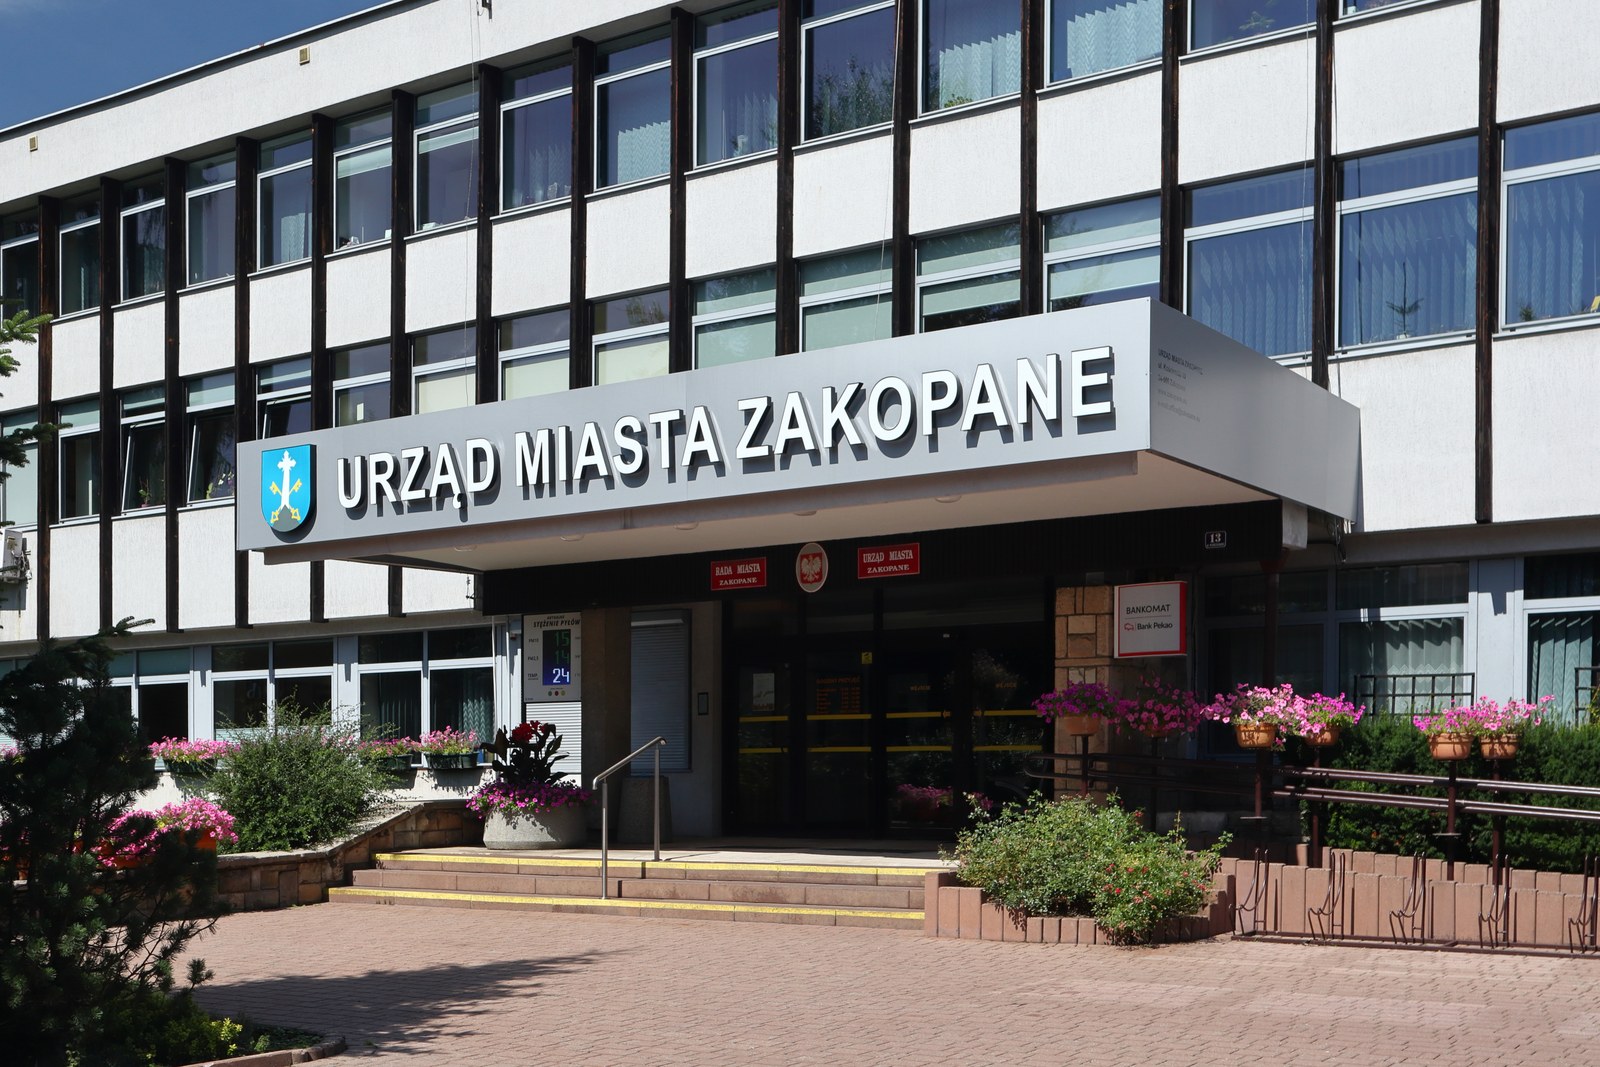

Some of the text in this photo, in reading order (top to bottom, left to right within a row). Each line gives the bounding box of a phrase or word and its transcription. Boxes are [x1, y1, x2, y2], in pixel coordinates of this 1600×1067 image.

[337, 345, 1114, 510] URZĄD MIASTA ZAKOPANE
[1210, 533, 1221, 543] 13
[863, 549, 914, 564] URZĄD MIASTA
[715, 563, 761, 576] RADA MIASTA
[867, 564, 910, 574] ZAKOPANE
[719, 577, 757, 586] ZAKOPANE
[1126, 604, 1171, 615] BANKOMAT
[533, 618, 580, 628] STĘŻENIE PYŁÓW
[1137, 622, 1152, 630] Bank
[555, 631, 569, 647] 15
[555, 649, 569, 665] 14
[552, 667, 570, 684] 24
